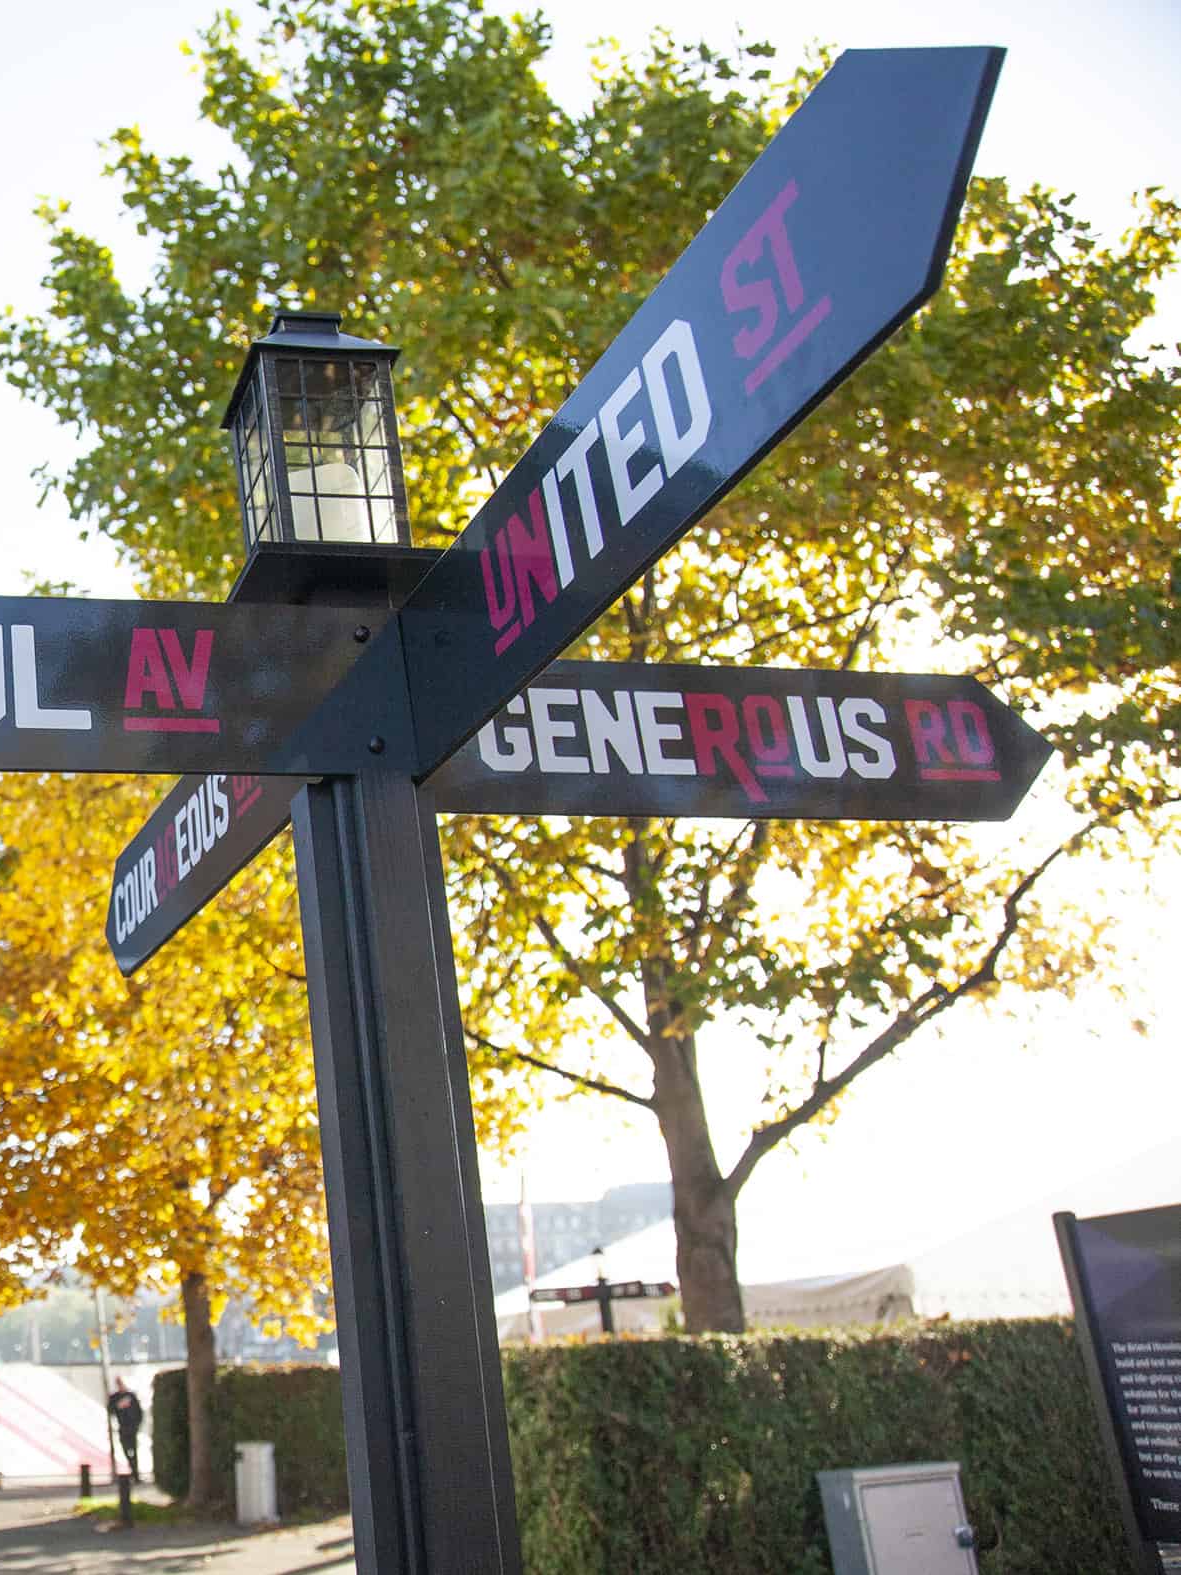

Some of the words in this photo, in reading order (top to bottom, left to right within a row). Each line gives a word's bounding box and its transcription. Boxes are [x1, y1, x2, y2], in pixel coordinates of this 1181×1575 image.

[480, 319, 712, 656] UNITED
[721, 178, 823, 386] ST
[123, 627, 219, 730] AV
[477, 687, 897, 801] GENEROUS
[905, 699, 1000, 780] RD
[114, 775, 229, 944] COURAGEOUS
